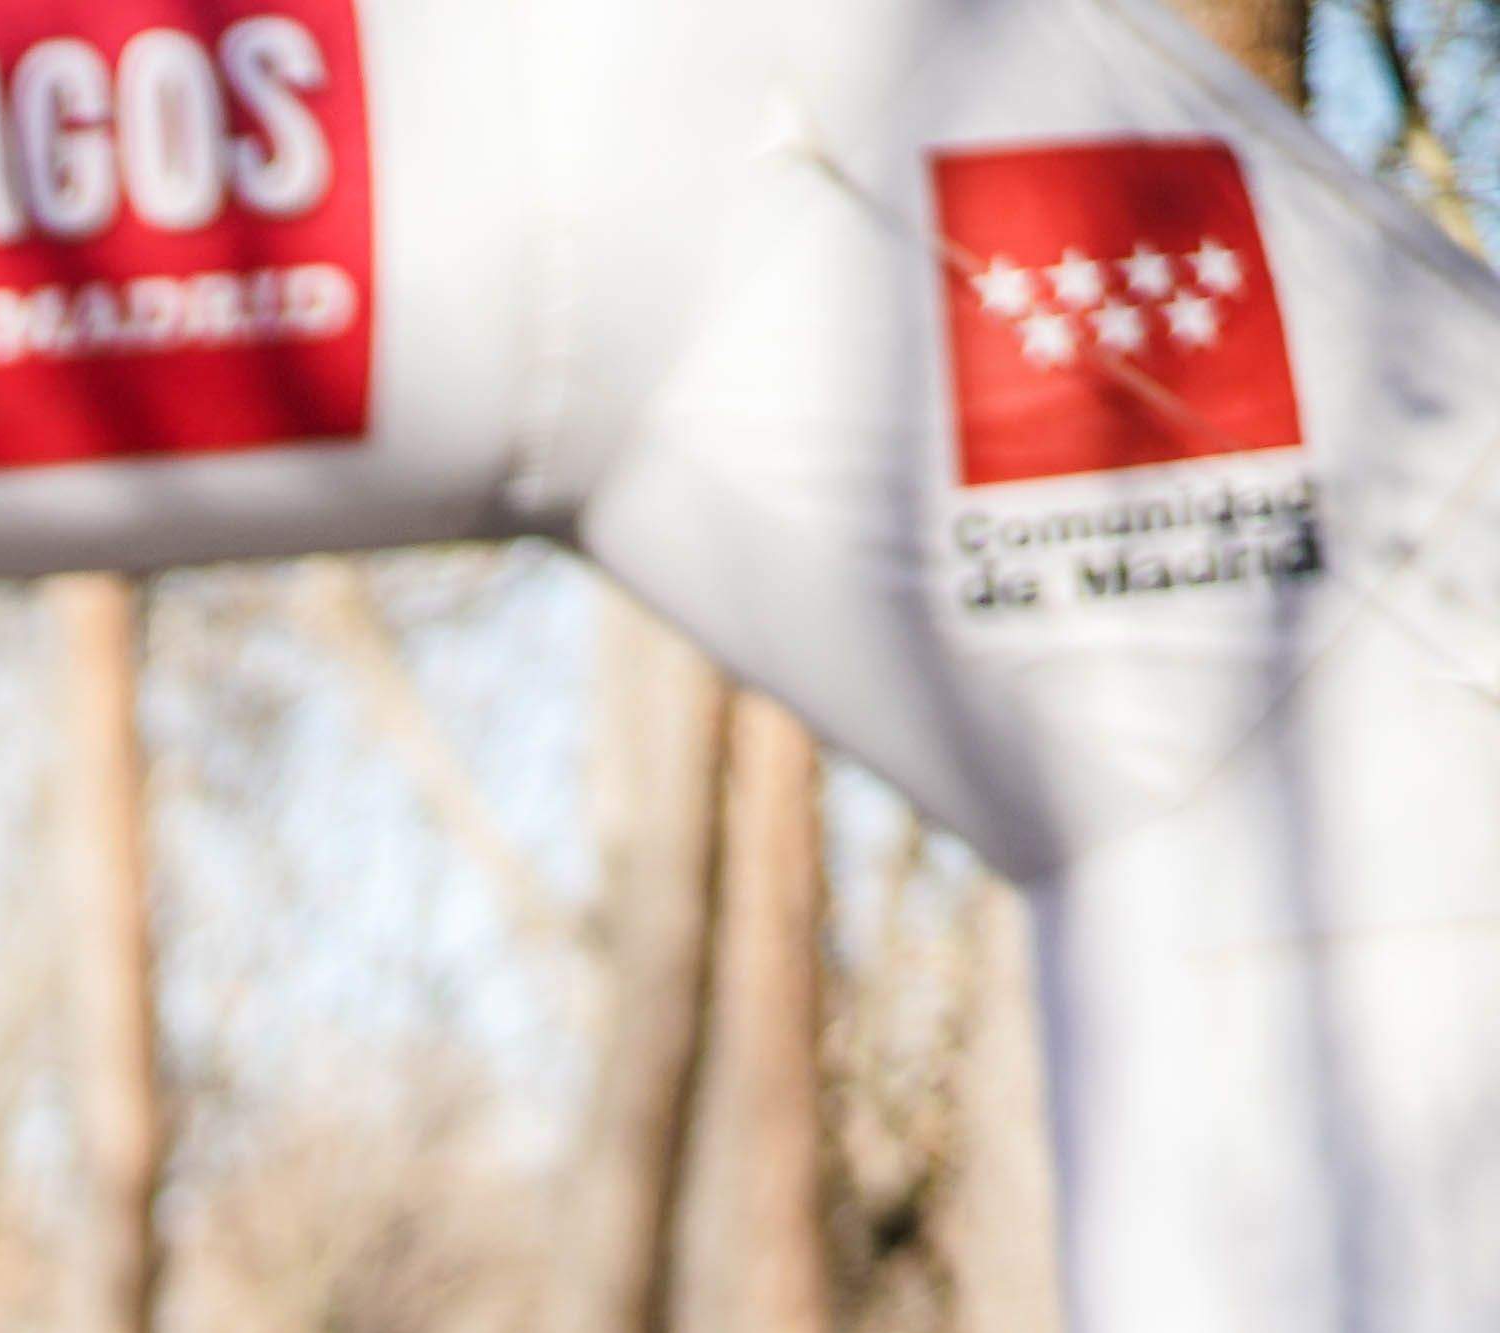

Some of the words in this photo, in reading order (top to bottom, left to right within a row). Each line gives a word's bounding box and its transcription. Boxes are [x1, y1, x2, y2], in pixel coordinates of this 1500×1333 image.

[953, 477, 1320, 554] Comunidad
[960, 562, 1041, 608] de
[1073, 521, 1326, 596] Madrid
